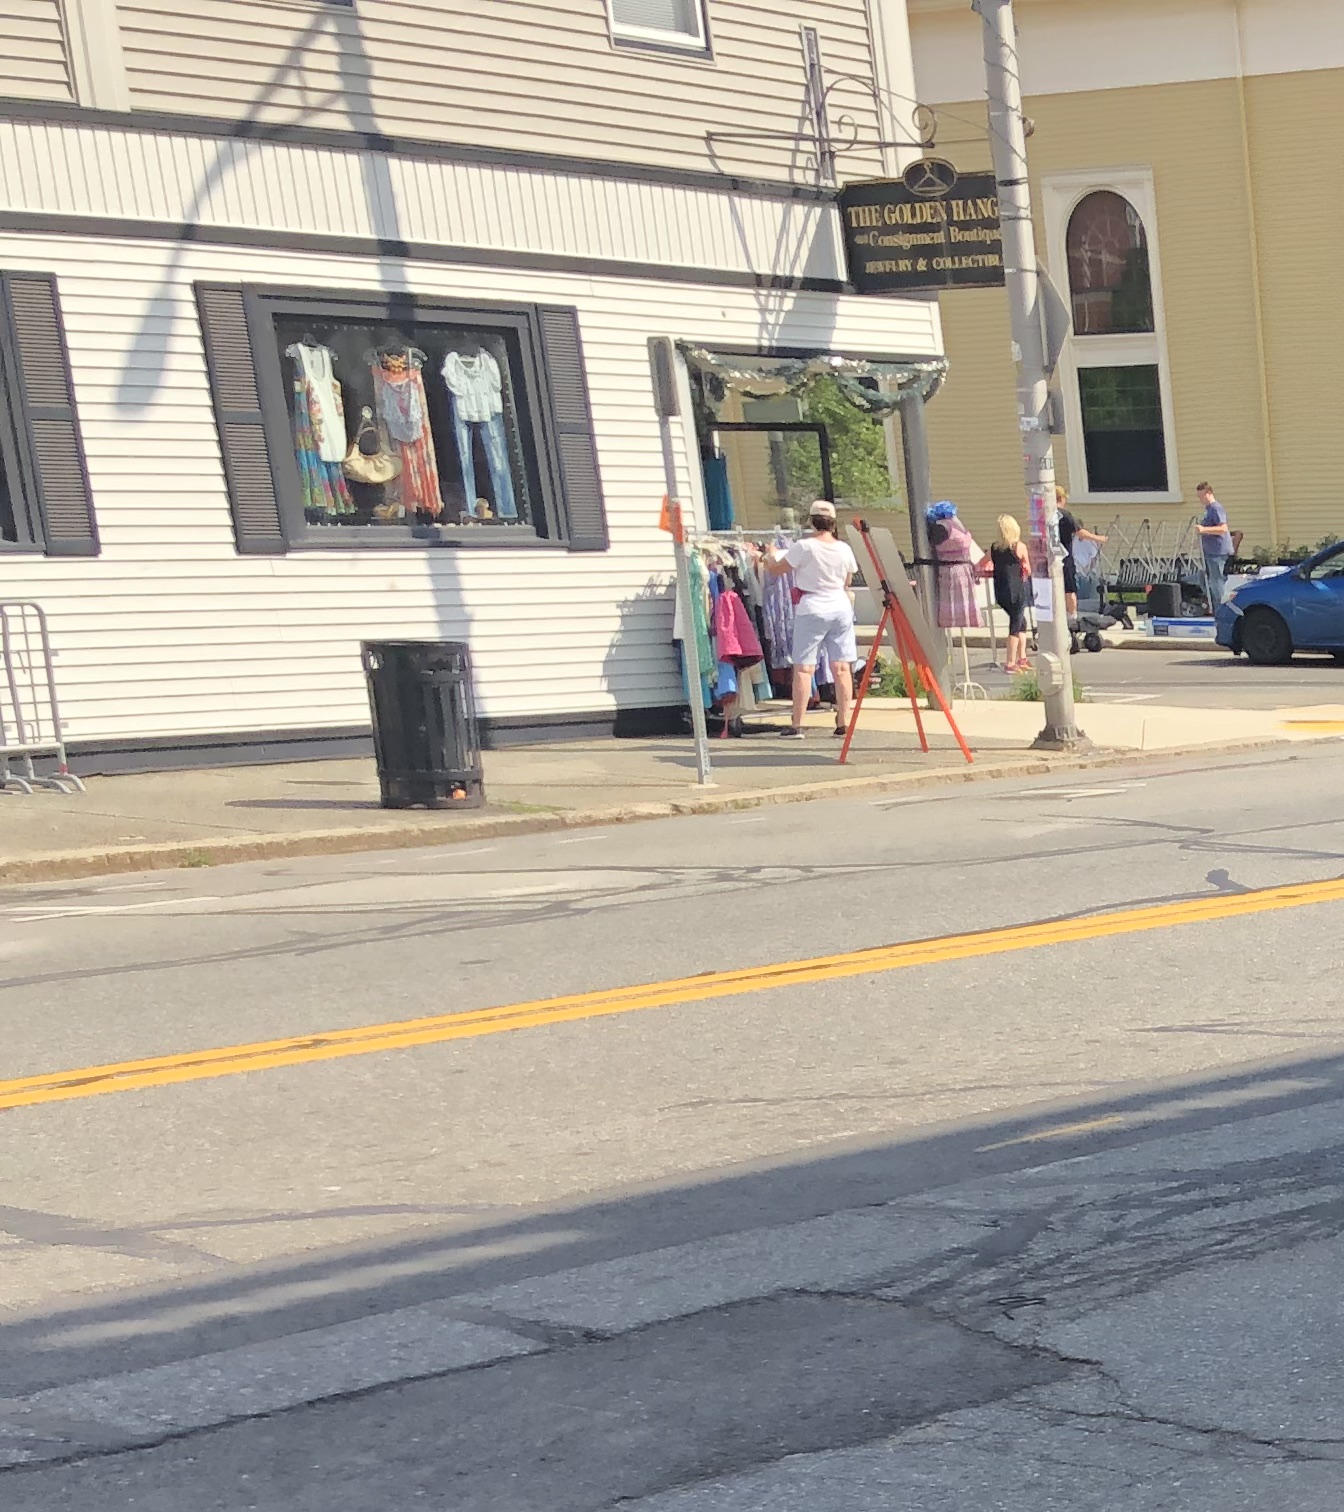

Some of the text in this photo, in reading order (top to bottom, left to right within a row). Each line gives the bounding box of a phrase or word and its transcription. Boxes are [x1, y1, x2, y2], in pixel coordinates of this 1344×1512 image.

[847, 197, 998, 227] THE GOLDEN HANG
[869, 230, 945, 250] Consignment
[932, 253, 1003, 270] COLLECTIBL
